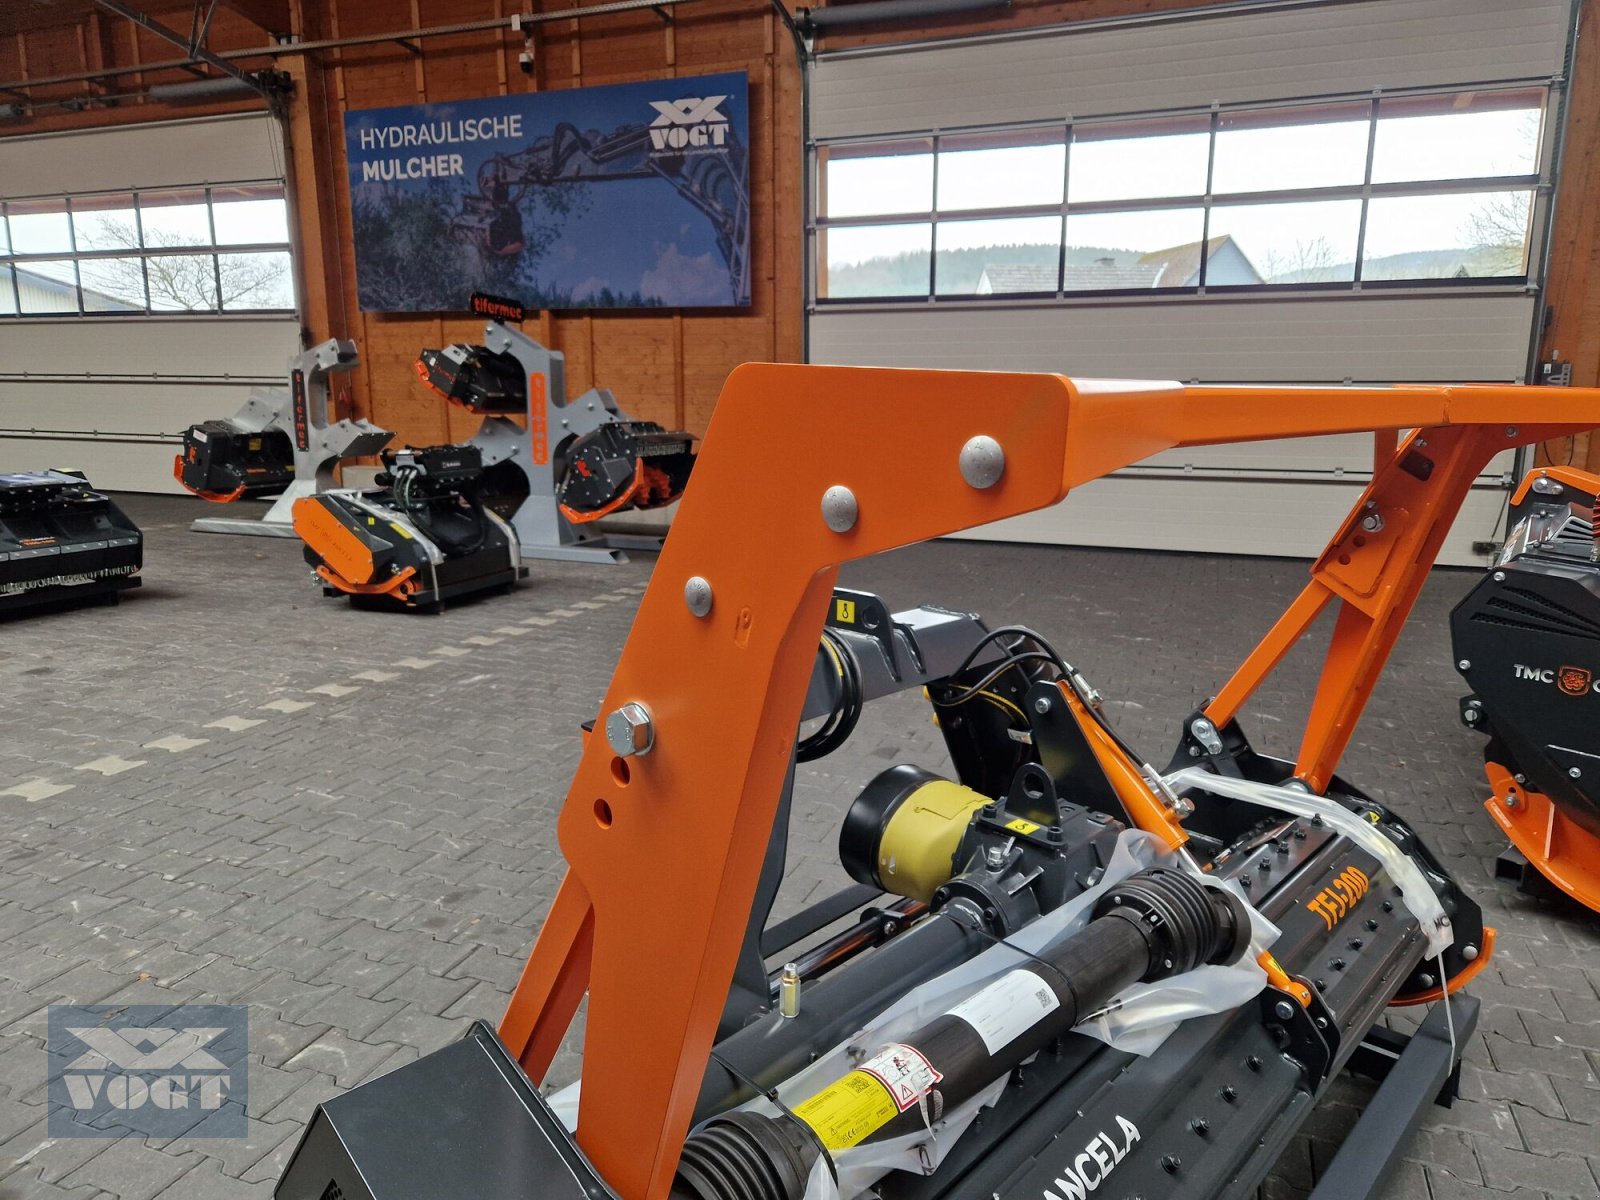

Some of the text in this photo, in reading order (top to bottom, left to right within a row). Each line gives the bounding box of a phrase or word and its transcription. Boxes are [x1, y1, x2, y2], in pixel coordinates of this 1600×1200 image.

[360, 114, 523, 150] HYDRAULISCHE
[649, 123, 729, 150] VOGT
[362, 154, 464, 182] MULCHER
[1513, 663, 1555, 684] TMC
